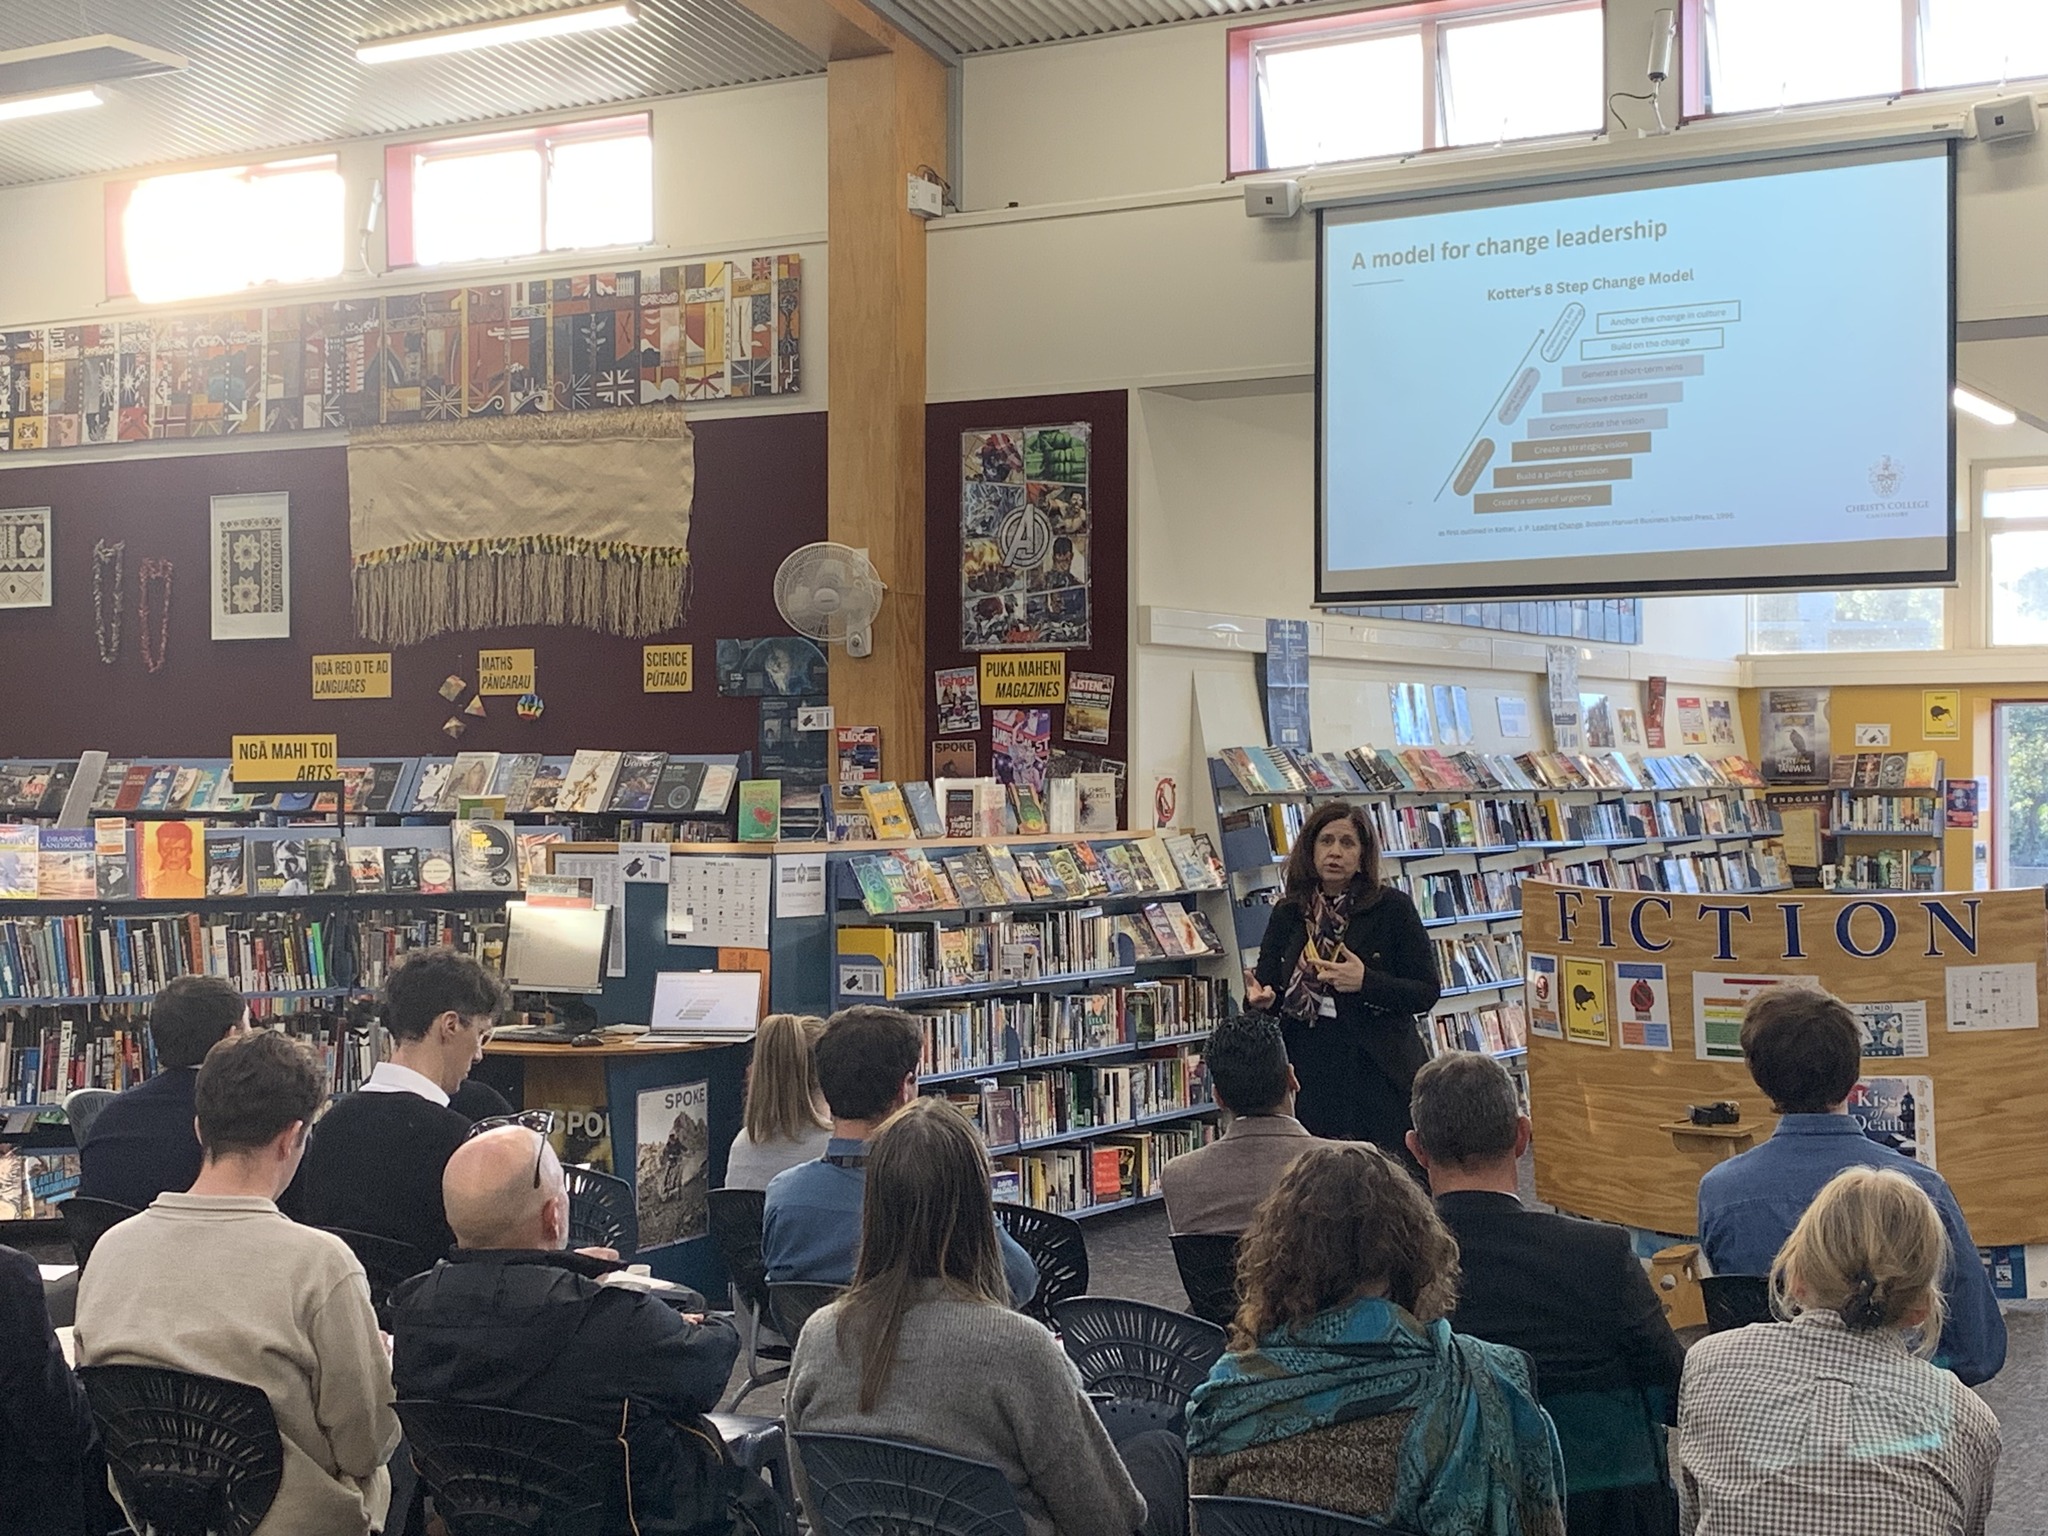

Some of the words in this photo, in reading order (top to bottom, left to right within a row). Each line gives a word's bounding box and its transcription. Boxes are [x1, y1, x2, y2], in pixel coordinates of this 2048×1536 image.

[1352, 252, 1366, 271] A
[1372, 244, 1435, 269] model
[1441, 239, 1470, 261] for
[1475, 230, 1549, 262] change
[1555, 219, 1668, 250] leadership
[1487, 281, 1542, 302] Kotter's
[1544, 282, 1553, 296] 8
[1556, 278, 1589, 298] Step
[1592, 273, 1645, 294] Change
[1648, 268, 1694, 287] Model
[1610, 315, 1639, 327] Anchor
[1641, 314, 1655, 324] the
[1656, 312, 1686, 325] change
[1687, 311, 1695, 320] in
[1696, 308, 1726, 321] culture
[1610, 342, 1629, 352] Build
[1631, 342, 1643, 350] on
[1645, 339, 1658, 349] the
[1660, 336, 1690, 349] change
[1581, 367, 1618, 380] Generate
[1619, 364, 1668, 377] short-term
[1669, 362, 1684, 373] wins
[1575, 394, 1608, 405] Remove
[1609, 391, 1649, 403] obstacles
[1549, 419, 1604, 432] Communicate
[1606, 417, 1619, 428] the
[1621, 415, 1645, 426] vision
[1534, 443, 1560, 455] Create
[1569, 440, 1603, 454] strategic
[1604, 438, 1629, 449] vision
[1516, 470, 1538, 481] Build
[1546, 467, 1573, 480] guiding
[1574, 465, 1609, 477] coalition
[1560, 492, 1592, 506] urgency
[1887, 499, 1930, 511] COLLEGE
[314, 659, 333, 676] NGĀ
[335, 660, 352, 676] REO
[354, 660, 361, 676] O
[363, 659, 374, 675] TE
[376, 658, 389, 674] AO
[481, 656, 513, 672] MATHS
[646, 651, 687, 668] SCIENCE
[986, 662, 1015, 678] PUKA
[1018, 660, 1061, 676] MAHENI
[314, 678, 366, 694] LANGUAGES
[481, 673, 531, 690] PĀNGARAU
[646, 670, 687, 688] PŪTAIAO
[938, 675, 975, 688] fishing
[995, 681, 1060, 698] MAGAZINES
[838, 730, 876, 742] autocar
[239, 742, 267, 760] NGĀ
[271, 742, 307, 760] MAHI
[311, 742, 332, 759] TOI
[935, 742, 974, 753] SPOKE
[623, 756, 662, 770] Universe
[297, 764, 333, 781] ARTS
[1773, 794, 1826, 804] ENDGAME
[837, 815, 871, 827] RUGBY
[1554, 890, 1983, 963] FICTION
[886, 953, 893, 967] A
[664, 1087, 705, 1109] SPOKE
[1856, 1090, 1897, 1107] Kiss
[1870, 1106, 1885, 1119] of
[35, 1175, 81, 1197] CARDBOARD
